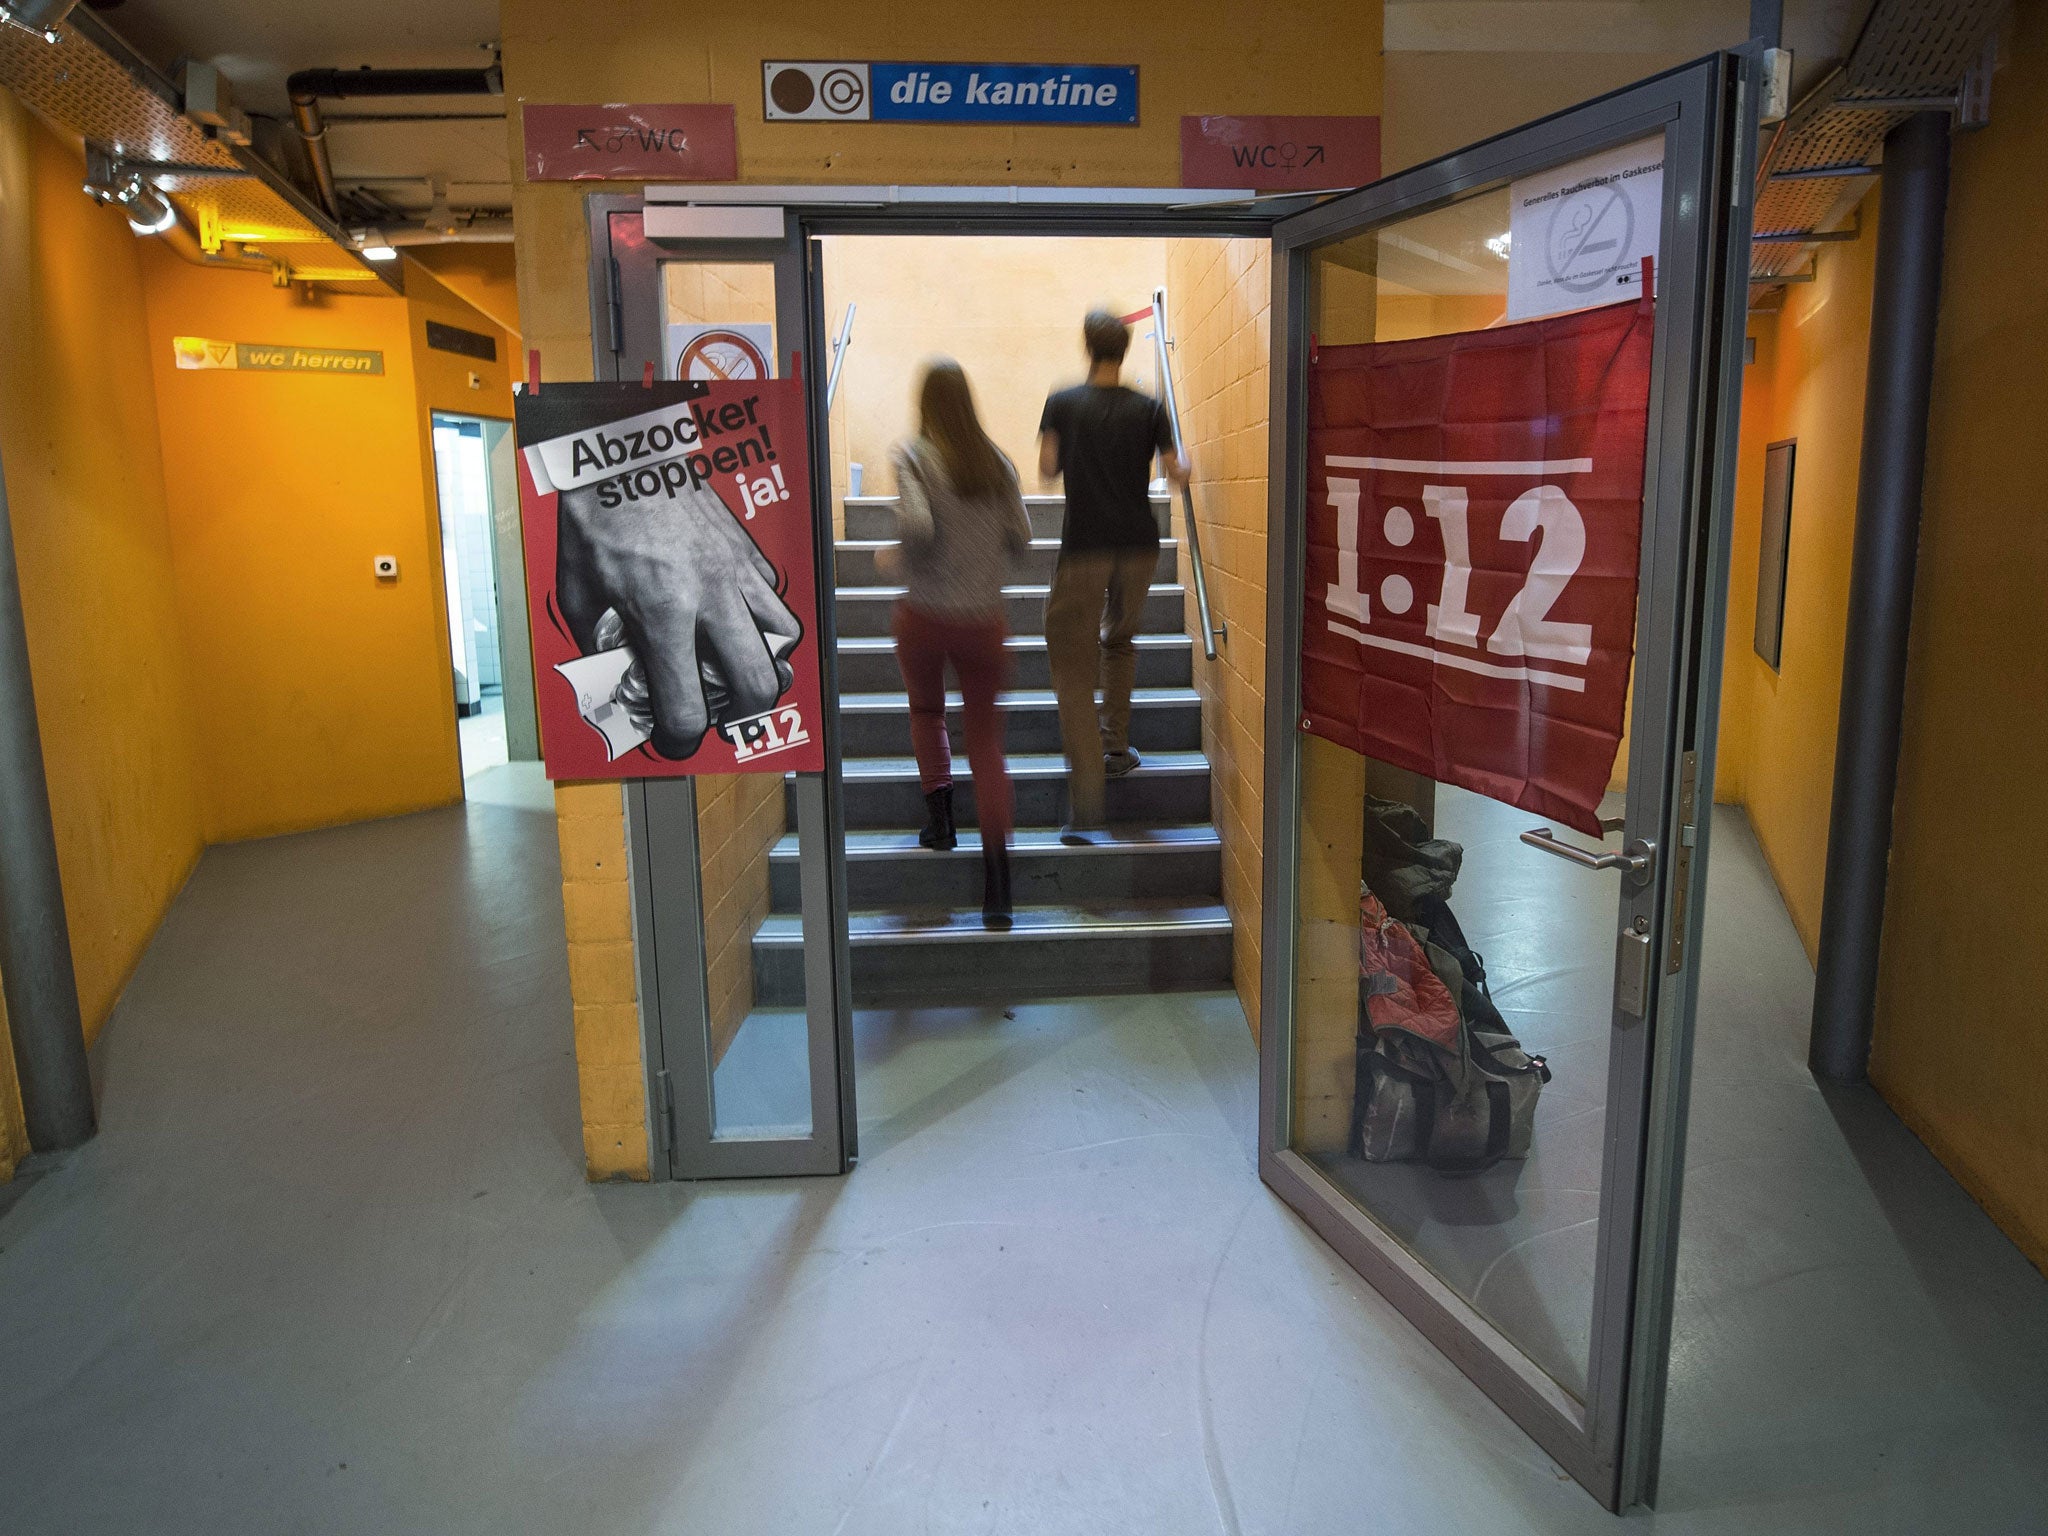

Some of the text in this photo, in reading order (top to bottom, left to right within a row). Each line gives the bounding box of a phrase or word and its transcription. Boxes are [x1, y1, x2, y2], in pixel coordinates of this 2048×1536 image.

[889, 72, 1118, 107] die kantine
[637, 128, 685, 153] WC
[1231, 145, 1276, 168] WC
[1523, 190, 1559, 207] Generelles
[1560, 176, 1608, 197] Rauchverbot
[1609, 173, 1621, 183] im
[250, 351, 372, 370] wc herren
[571, 395, 759, 478] Abzocker
[596, 425, 776, 509] stoppen!
[735, 463, 790, 520] ja!
[1325, 476, 1592, 666] 1:12
[725, 708, 809, 760] 1:12
